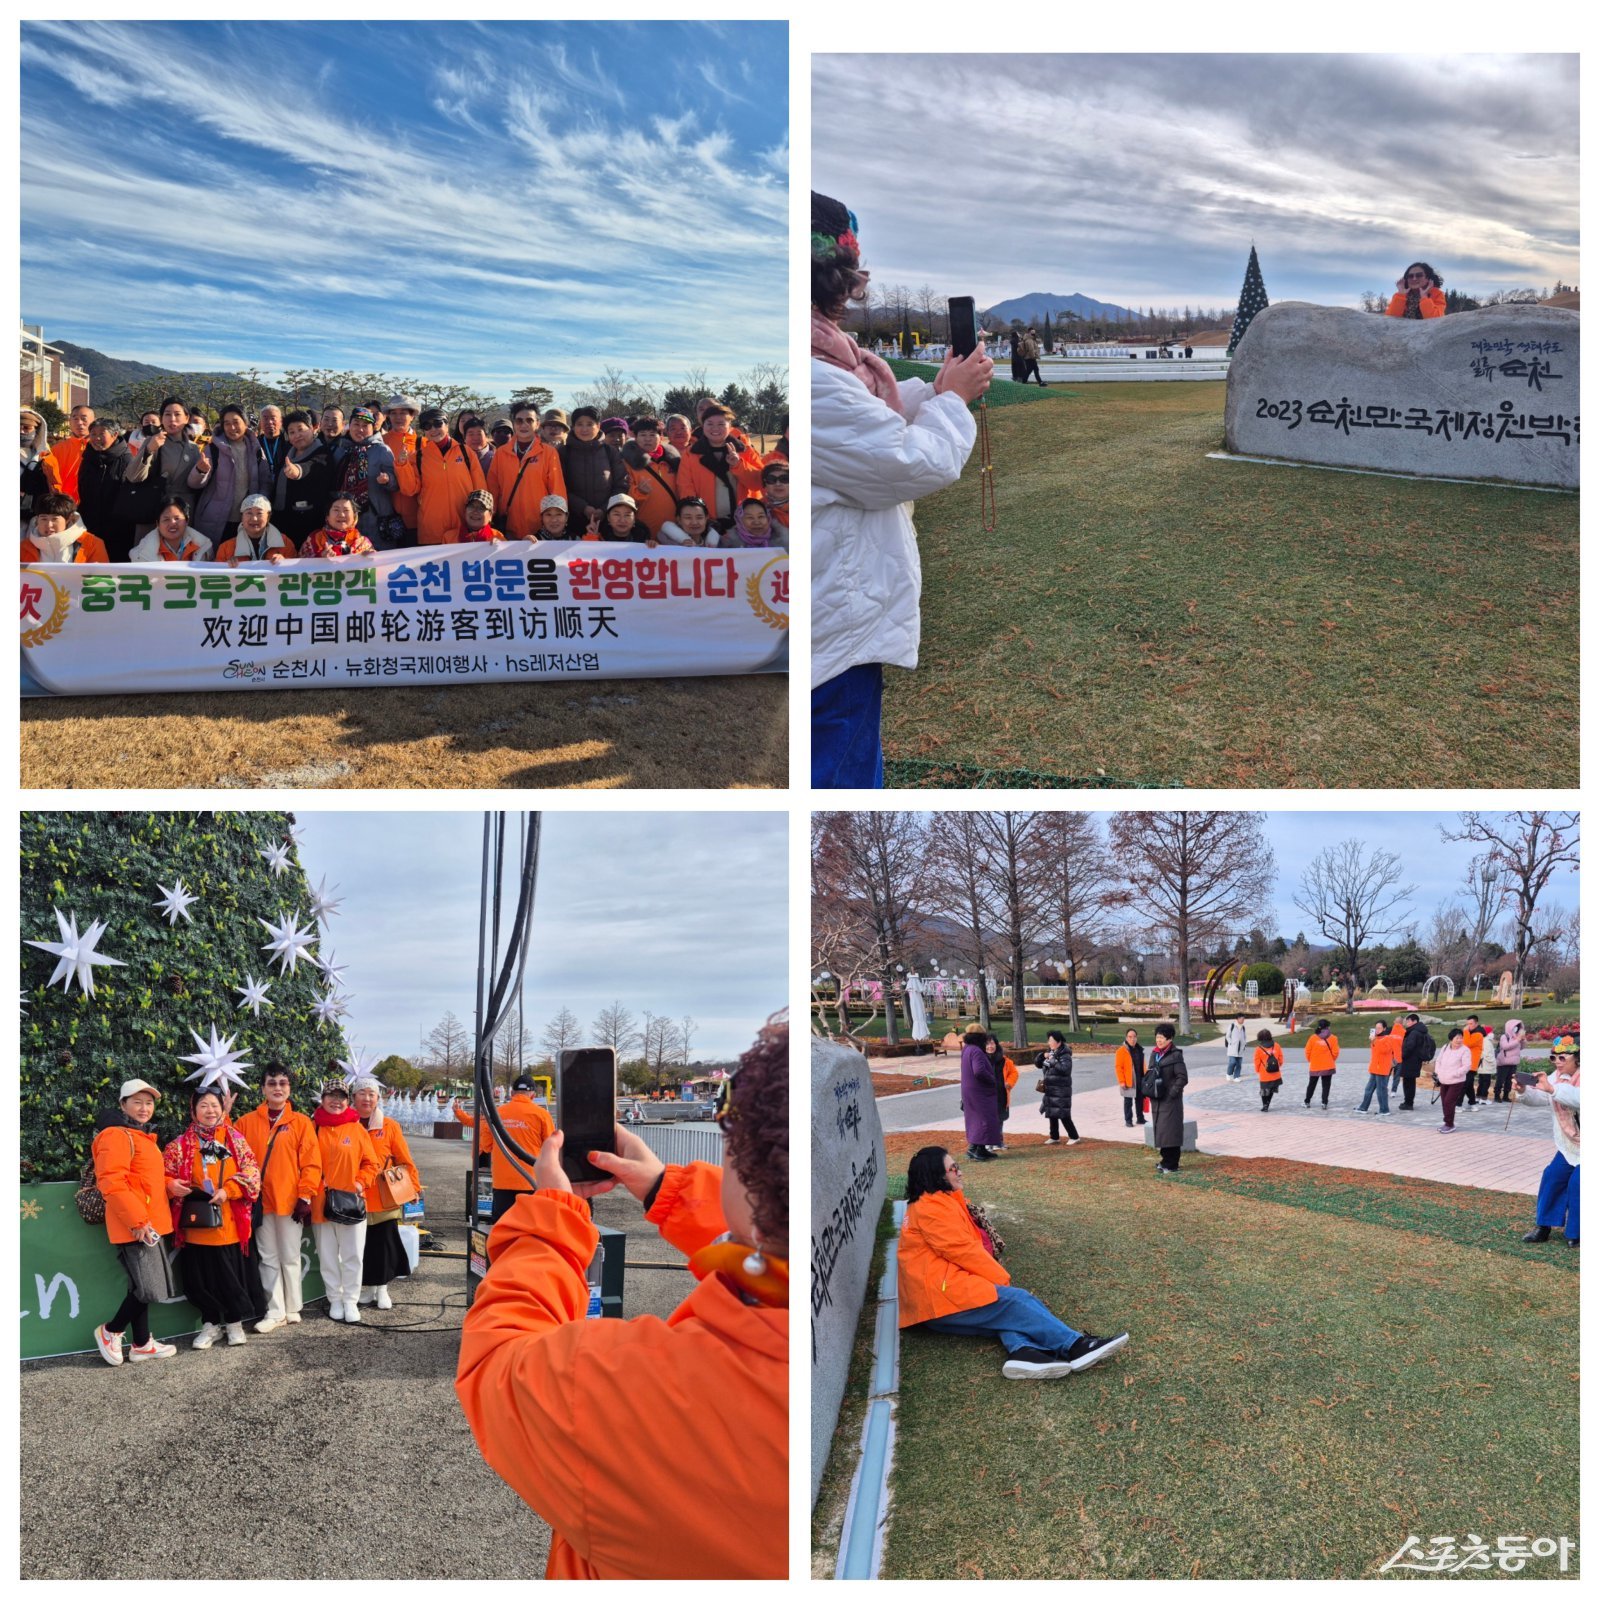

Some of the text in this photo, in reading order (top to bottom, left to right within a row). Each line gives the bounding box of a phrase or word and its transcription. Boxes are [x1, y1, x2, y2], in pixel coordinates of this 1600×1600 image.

[1498, 356, 1564, 392] 순천
[1256, 398, 1303, 430] 2023
[80, 556, 739, 613] 중국 크루즈 관광객 순천 방문을 환영합니다
[200, 604, 619, 649] 欢迎中国邮轮游客到访顺天
[272, 652, 600, 679] 순천시 뉴화청국제여행사 hs레저산업
